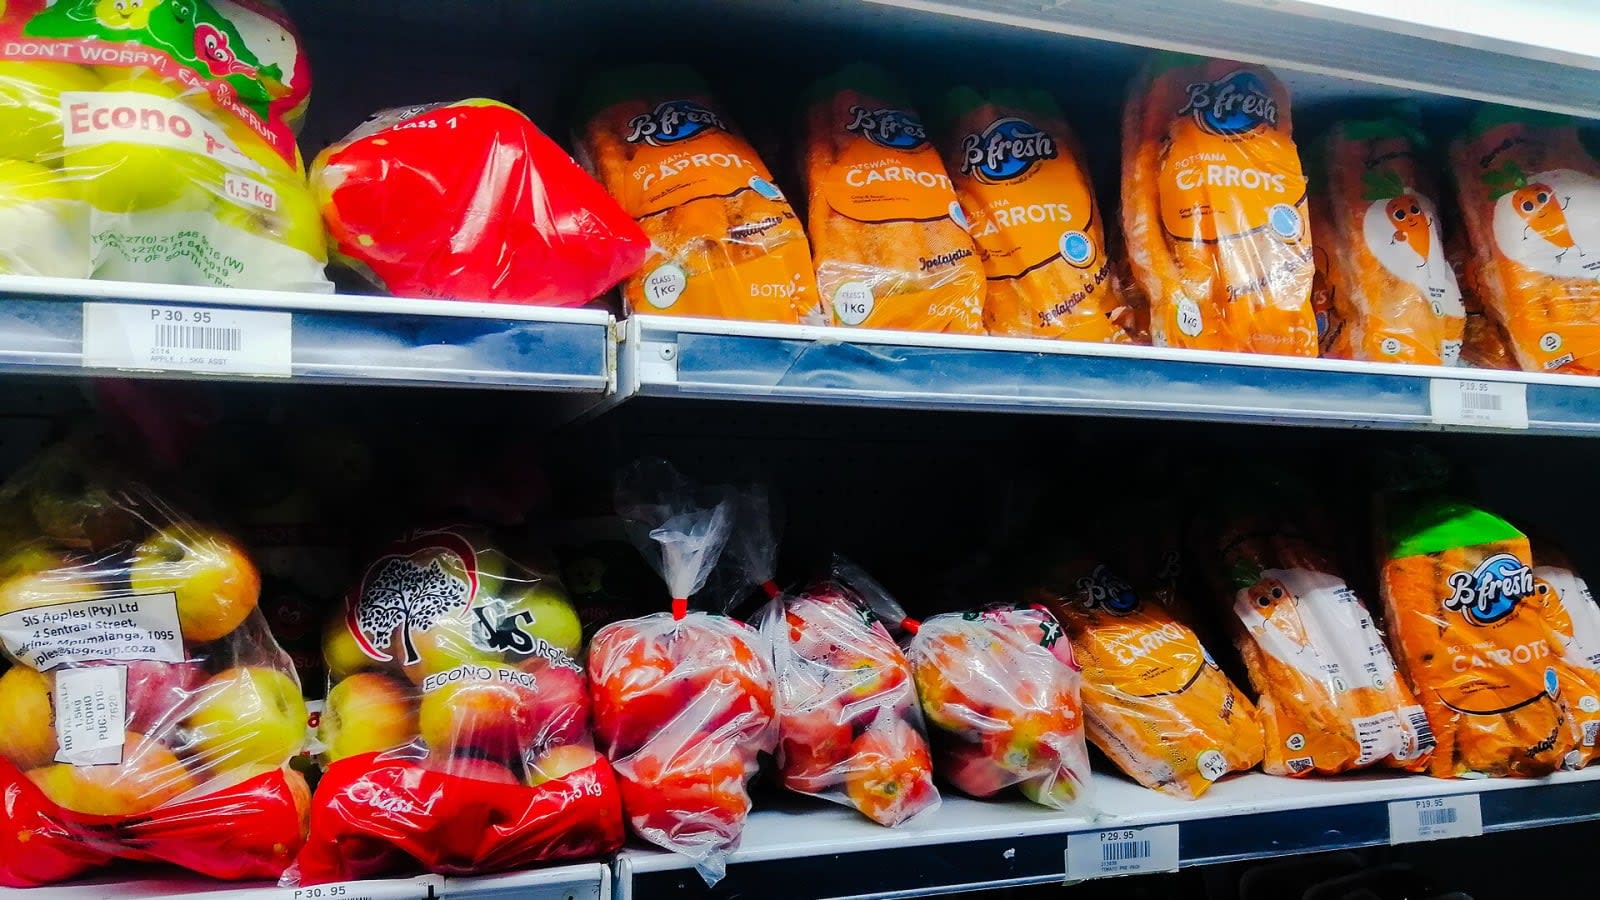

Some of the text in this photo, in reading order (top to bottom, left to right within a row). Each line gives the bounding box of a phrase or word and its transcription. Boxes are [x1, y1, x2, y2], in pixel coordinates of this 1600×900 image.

[5, 43, 69, 57] DON'T
[80, 45, 167, 71] WORRY!
[178, 68, 210, 87] EA
[69, 103, 193, 138] Econo
[446, 117, 458, 129] 1
[254, 185, 274, 209] kg
[144, 255, 161, 263] OF
[652, 276, 672, 285] CLASS
[22, 601, 139, 628] SIS Apples (Pty) Ltd
[33, 617, 137, 639] 4 Sentraal Street,
[148, 630, 175, 641] 1095
[425, 667, 492, 691] ECONO
[83, 695, 94, 731] ECONO
[584, 781, 602, 797] kg
